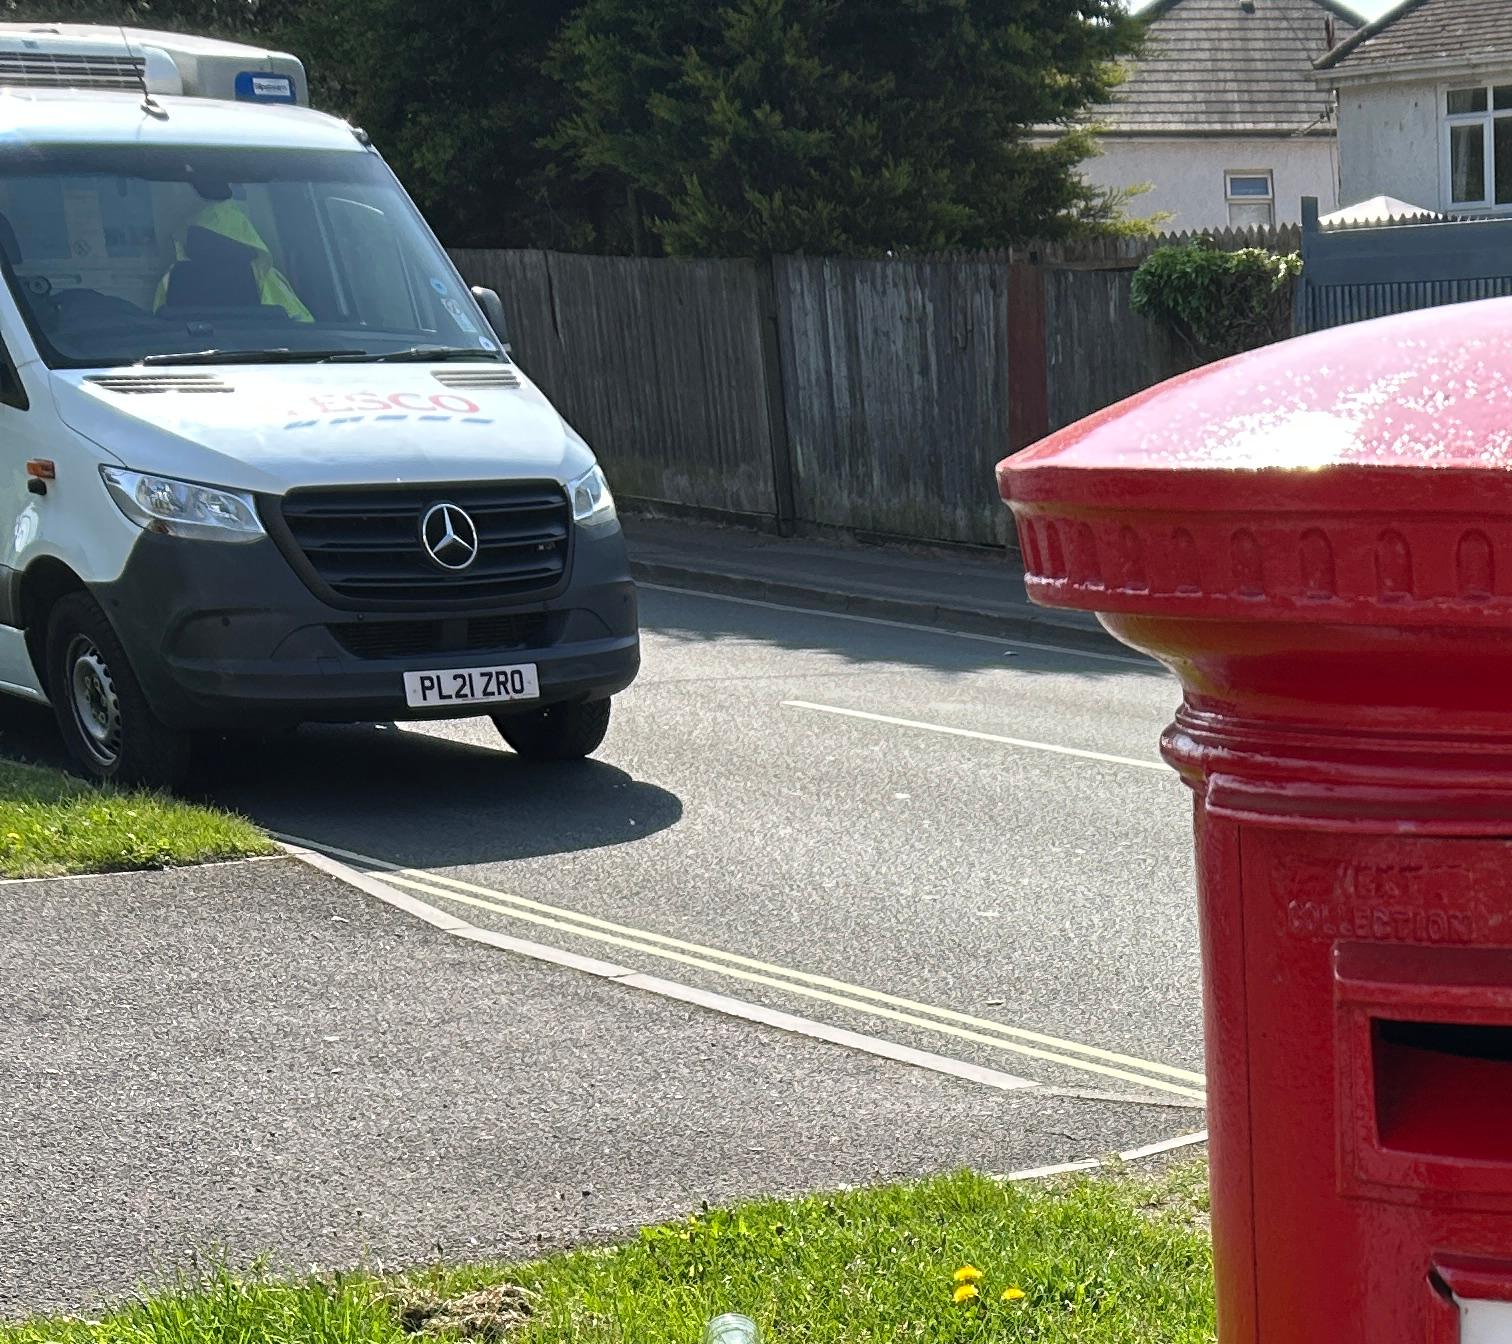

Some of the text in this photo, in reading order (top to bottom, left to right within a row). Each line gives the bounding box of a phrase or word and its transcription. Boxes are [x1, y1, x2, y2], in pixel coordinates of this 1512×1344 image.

[288, 391, 479, 414] ESCO
[419, 669, 525, 701] PL21 ZRO
